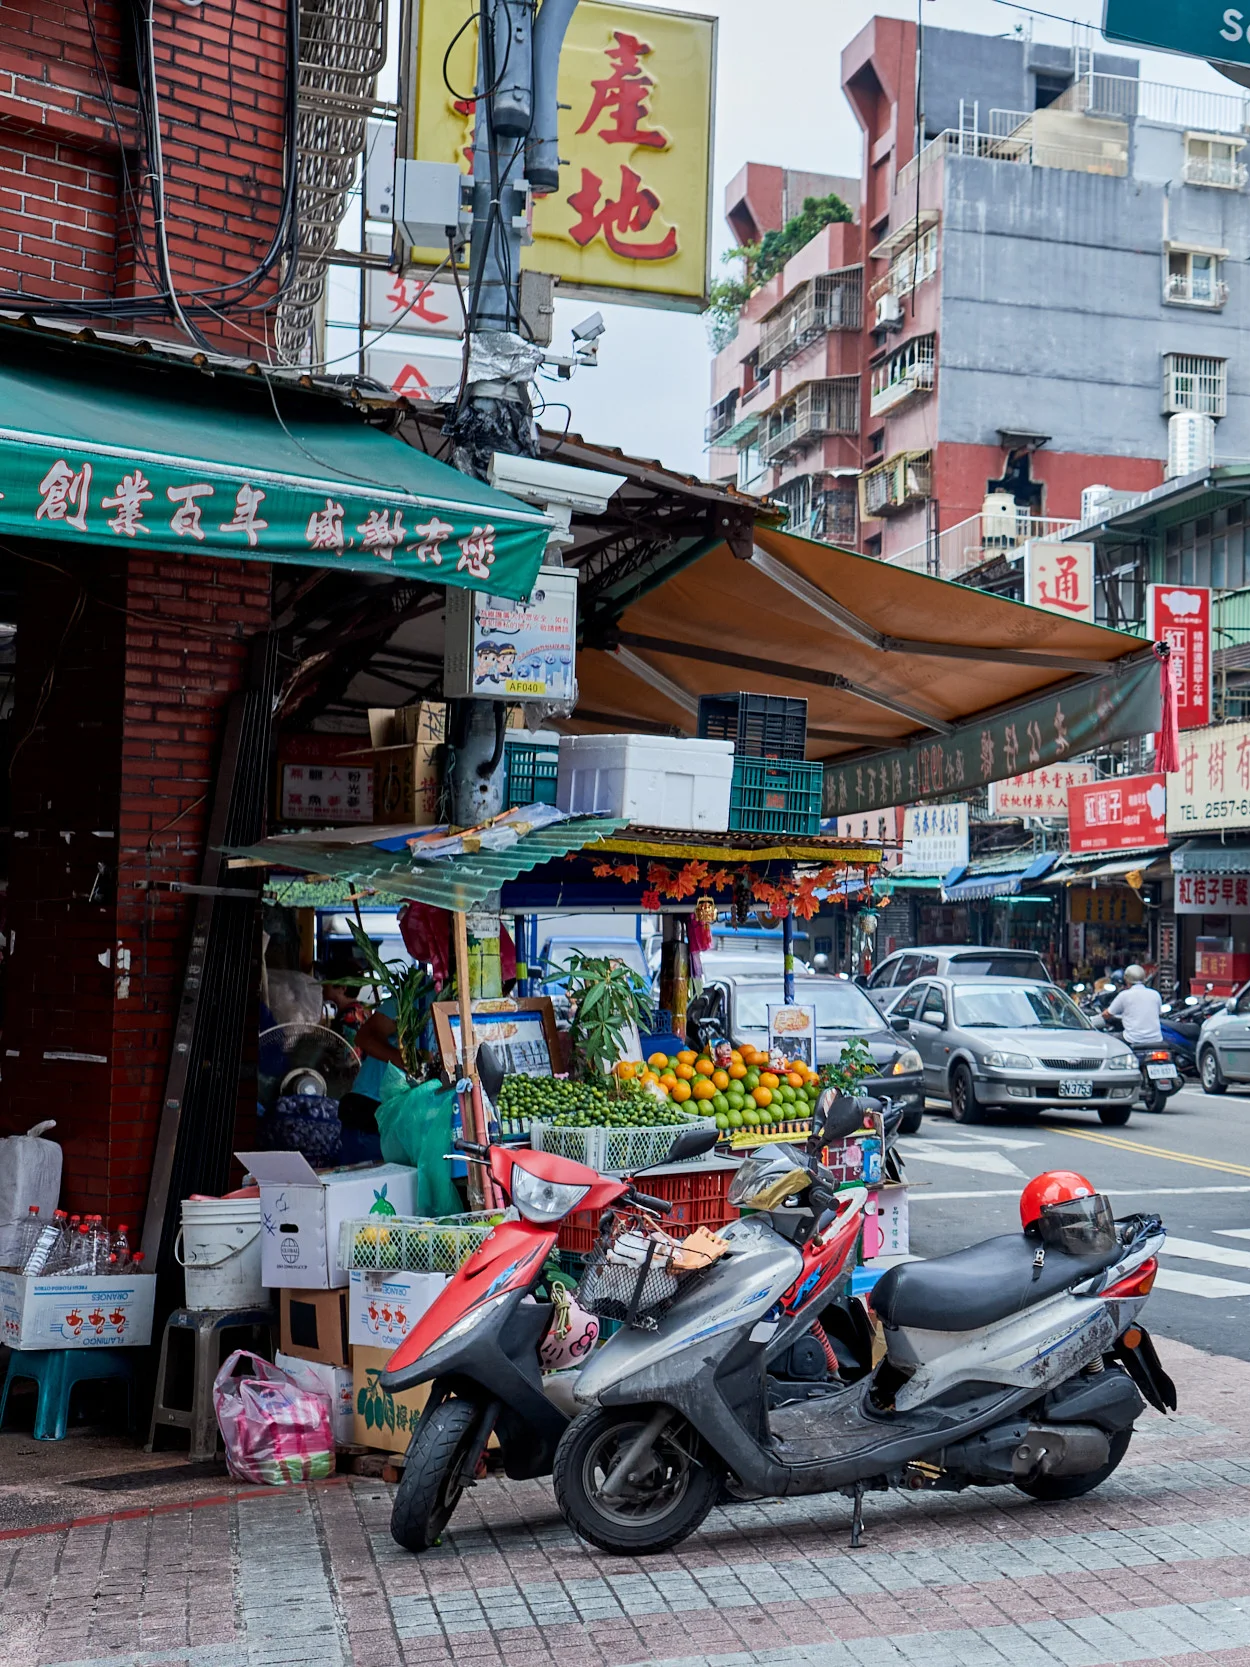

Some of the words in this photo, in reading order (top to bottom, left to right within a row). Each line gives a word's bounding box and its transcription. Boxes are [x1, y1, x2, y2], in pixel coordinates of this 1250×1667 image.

[567, 31, 678, 260] 產地
[35, 457, 270, 547] 創業百年
[1038, 555, 1090, 613] 通
[509, 684, 538, 692] AF040
[1179, 876, 1249, 905] 紅桔子早餐
[91, 1293, 129, 1302] ORANGES
[83, 1336, 125, 1347] FLAMINGO
